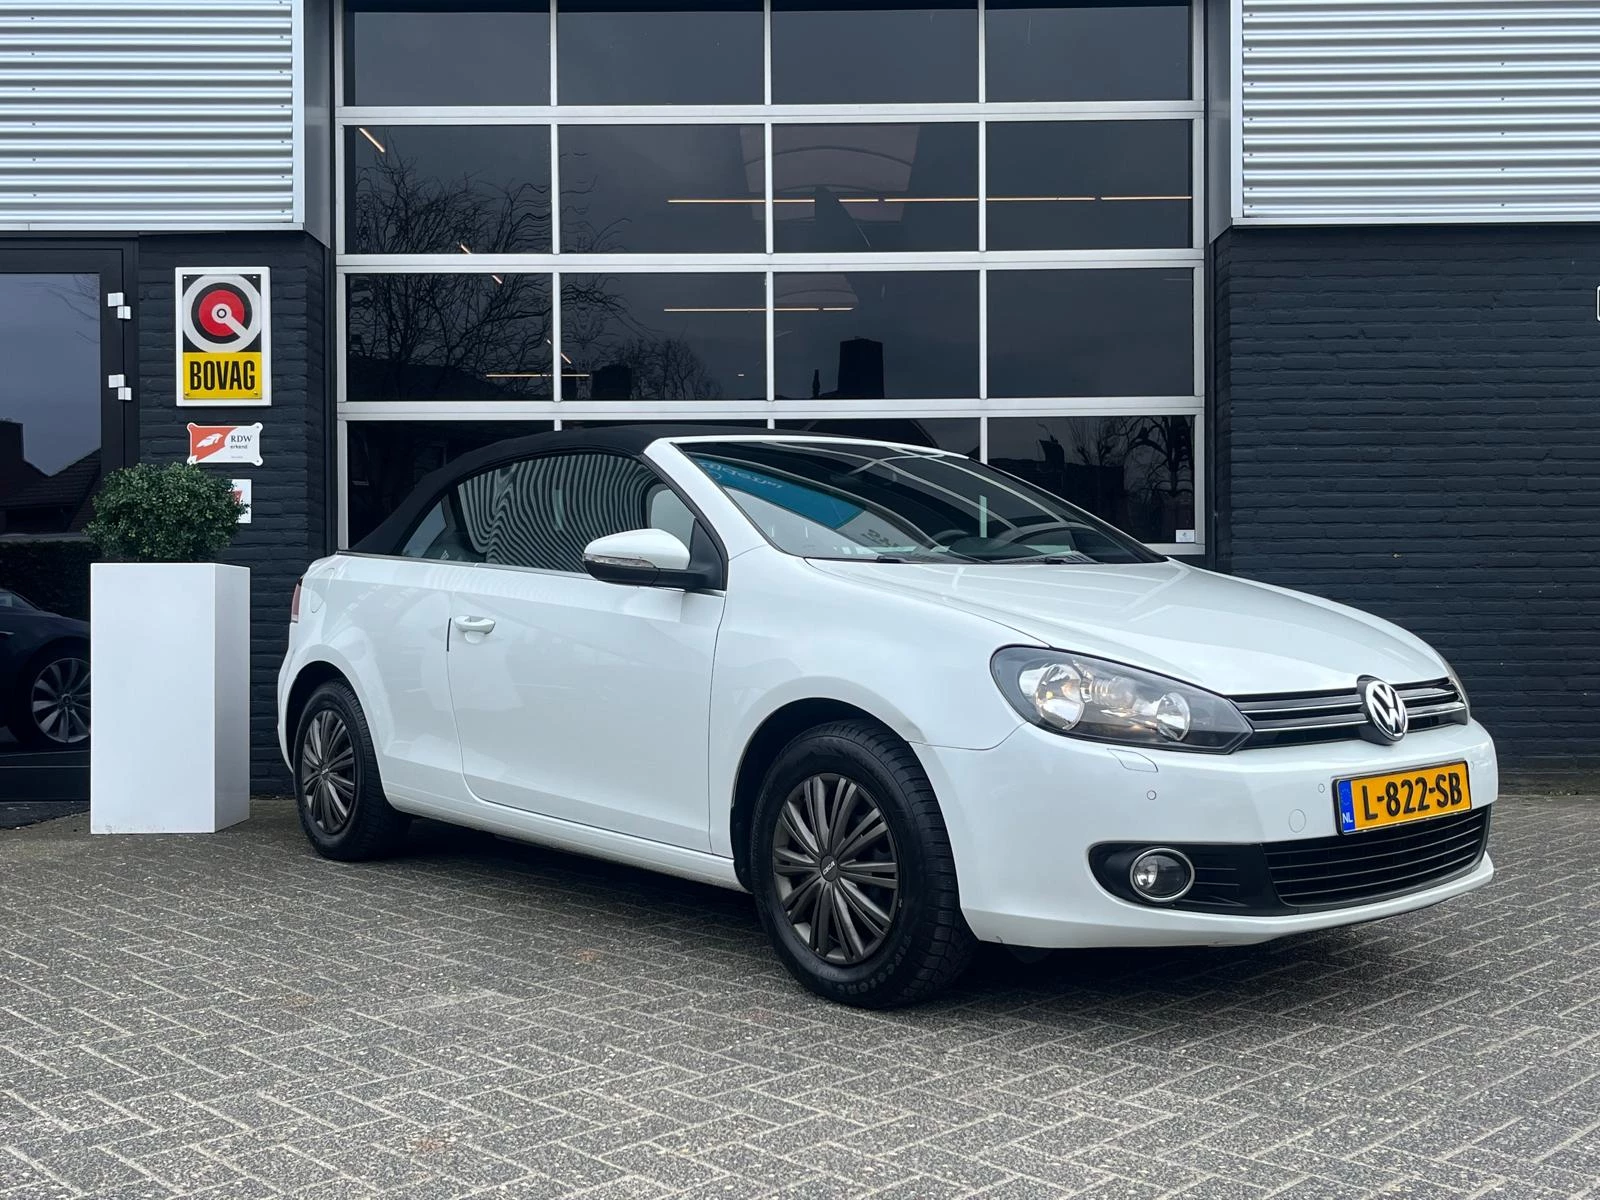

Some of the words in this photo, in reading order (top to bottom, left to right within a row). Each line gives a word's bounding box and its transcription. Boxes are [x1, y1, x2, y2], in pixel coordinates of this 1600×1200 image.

[189, 360, 255, 391] BOVAG
[230, 435, 252, 443] RDW
[1362, 772, 1463, 820] L-822-SB
[1342, 811, 1354, 824] NL
